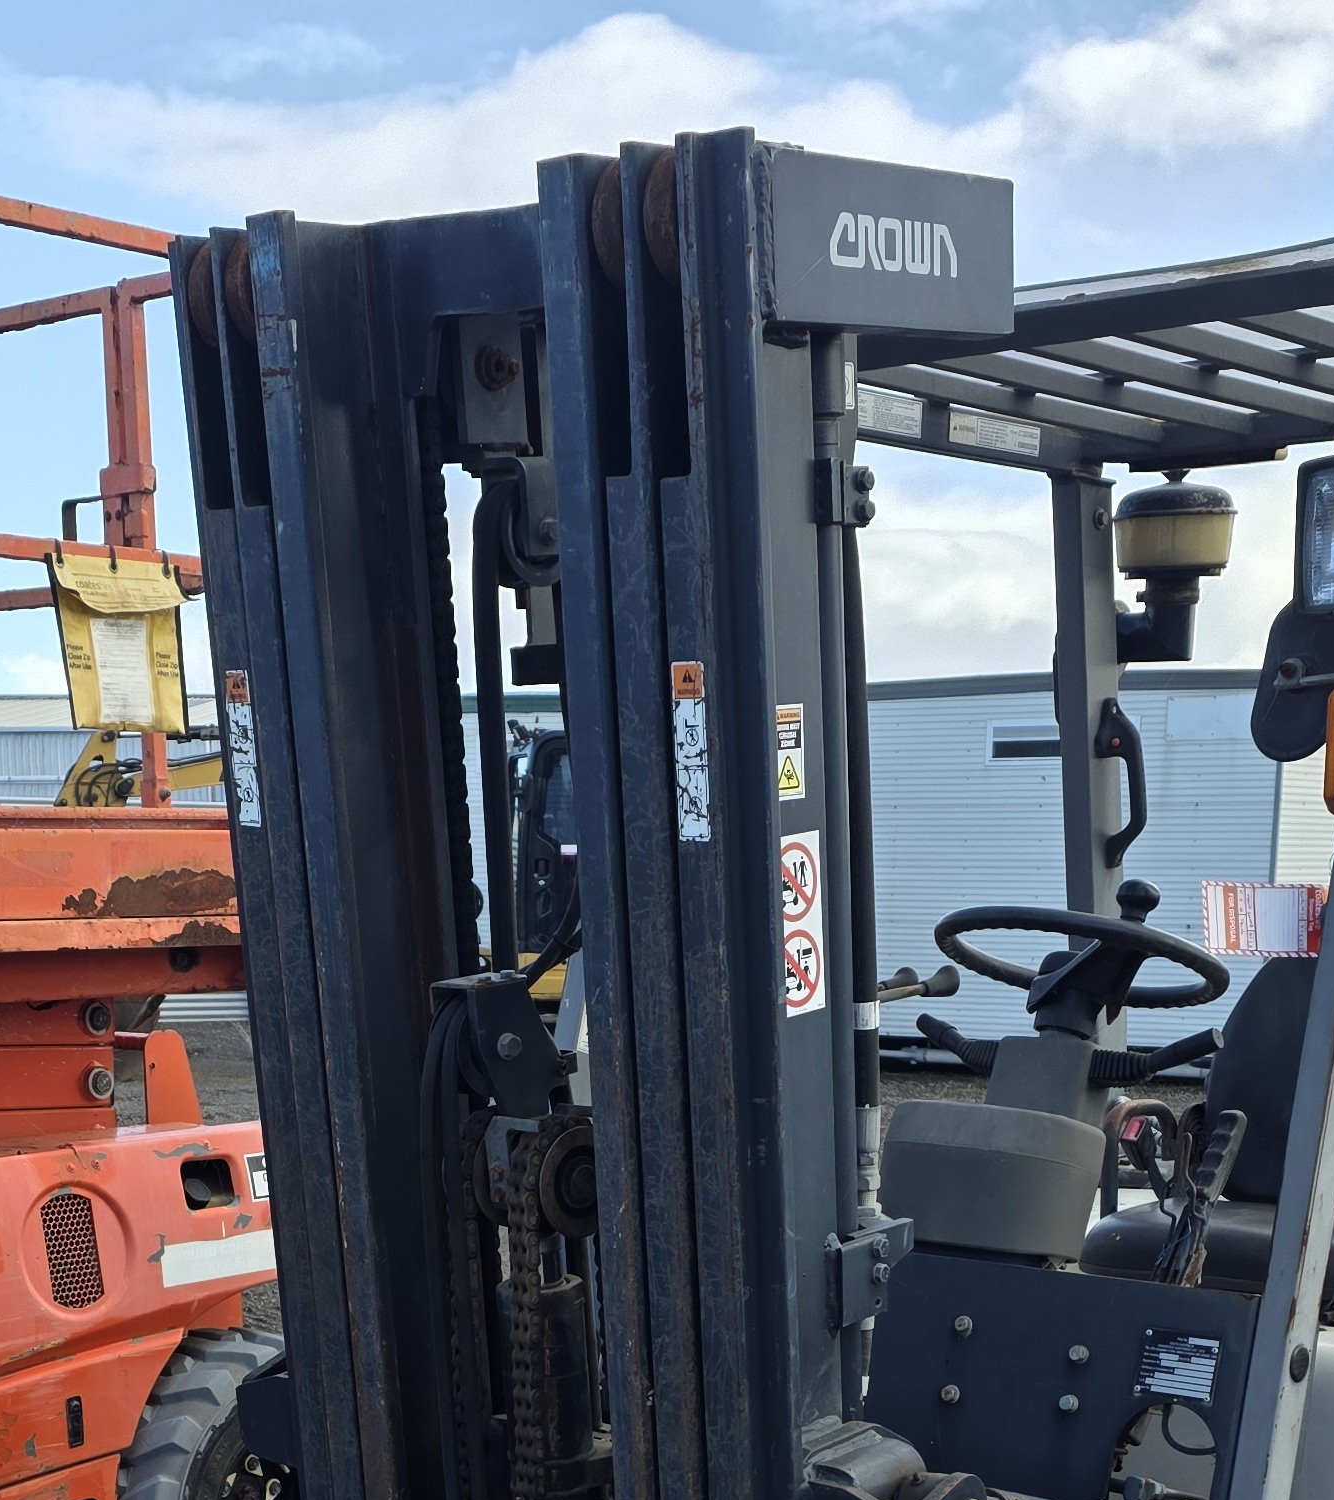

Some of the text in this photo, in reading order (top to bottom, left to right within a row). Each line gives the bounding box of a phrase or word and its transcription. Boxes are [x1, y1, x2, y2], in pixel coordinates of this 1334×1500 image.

[830, 211, 958, 278] CROWN
[1227, 892, 1237, 944] FOR DISPOSAL
